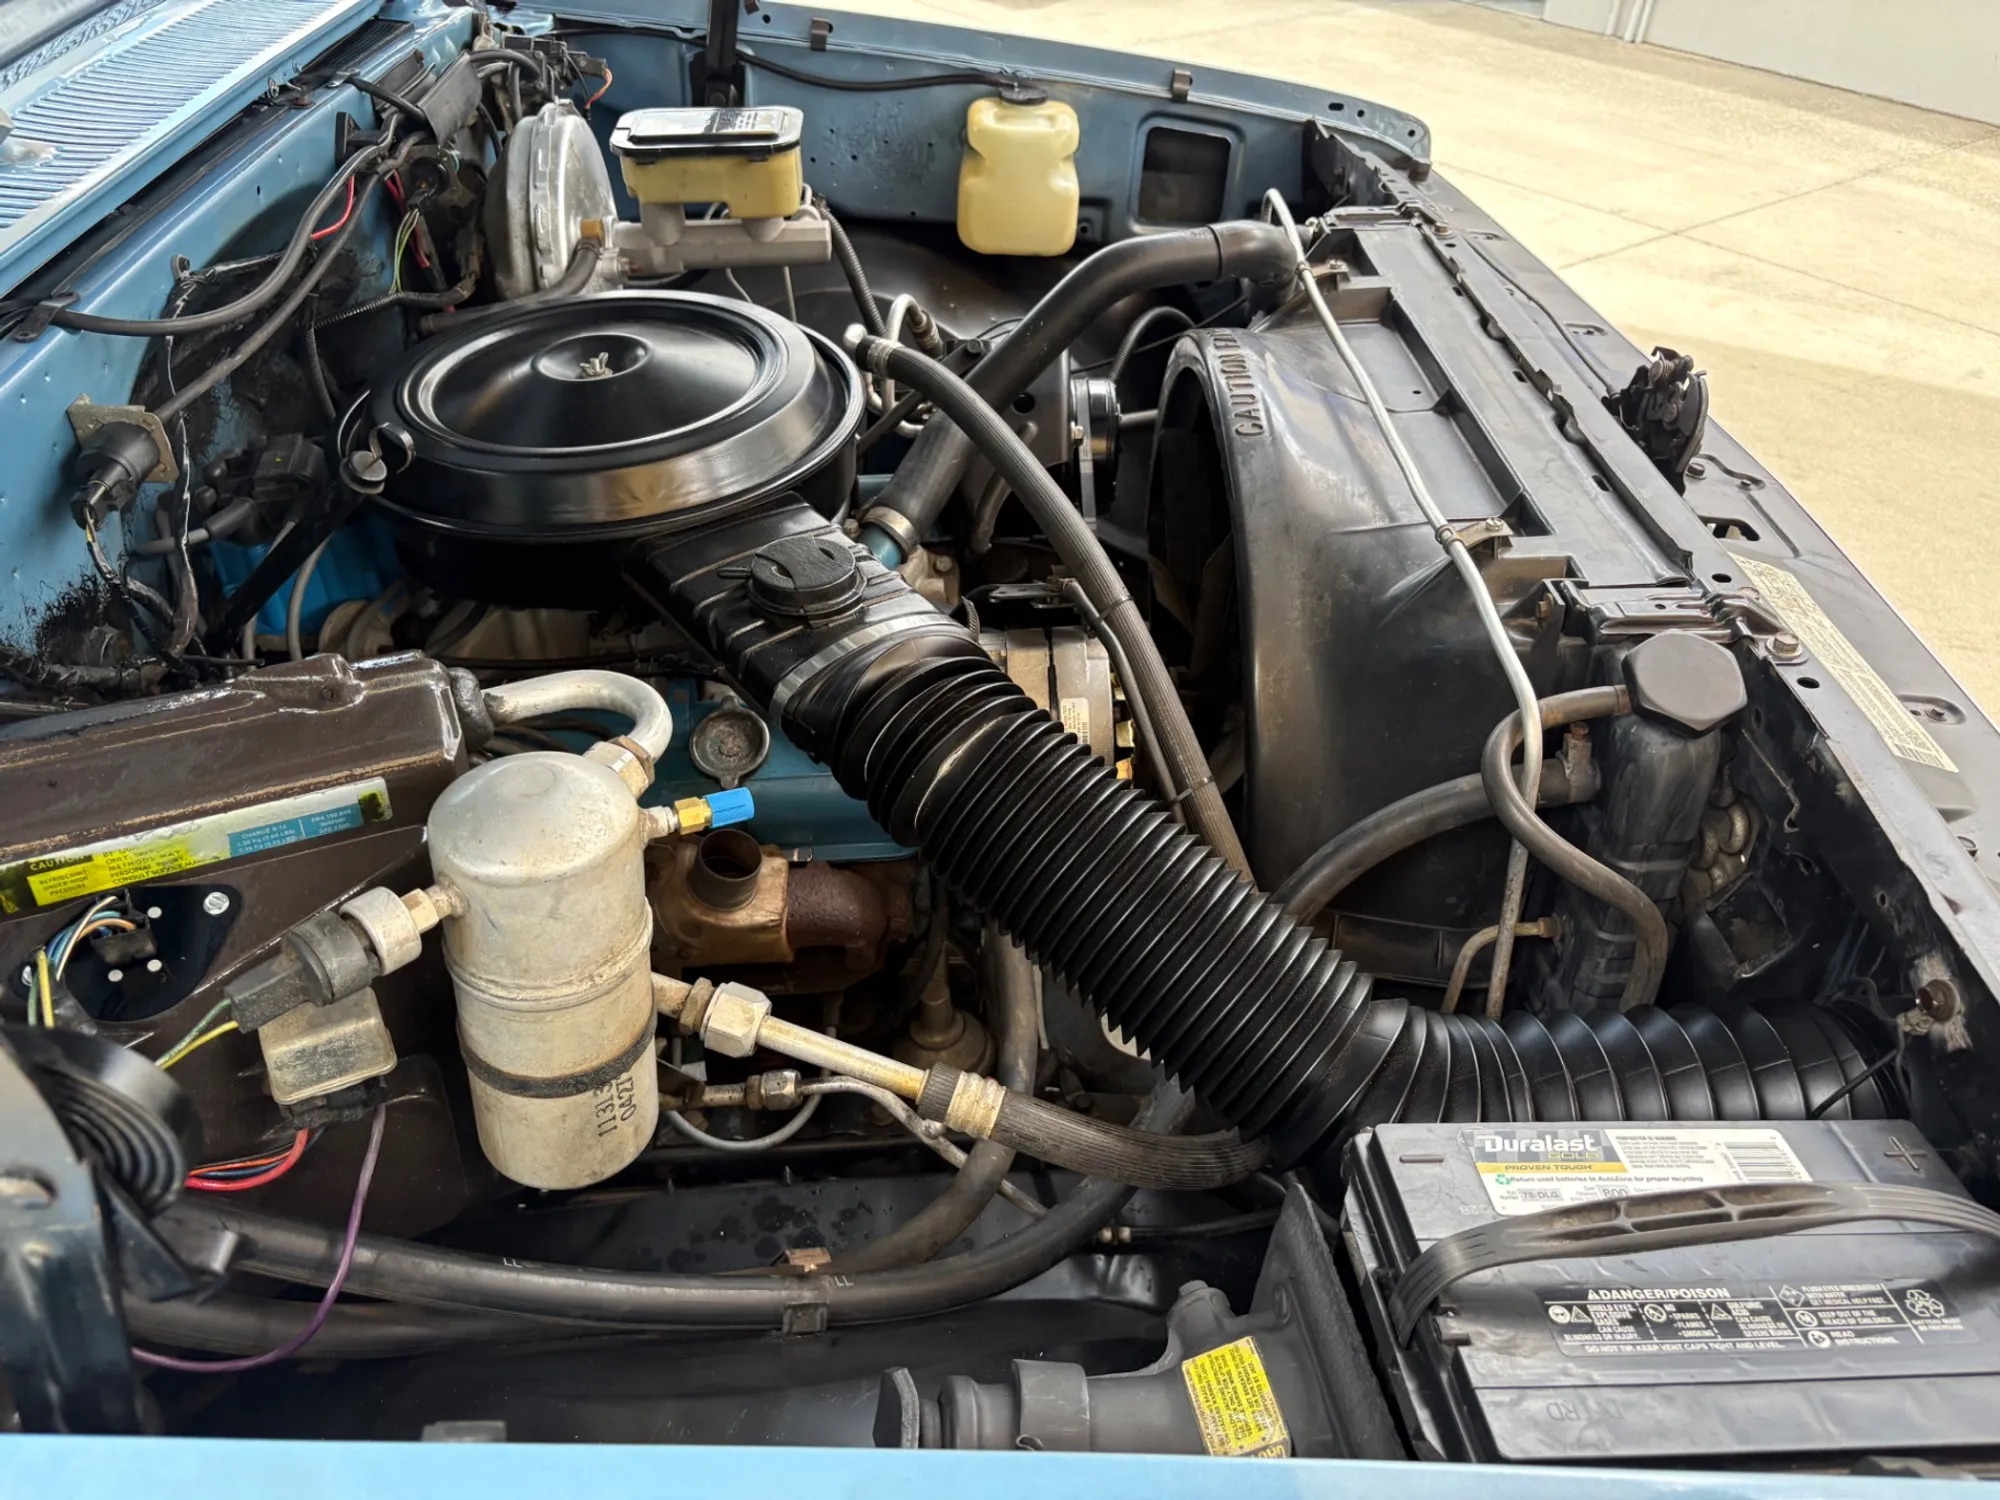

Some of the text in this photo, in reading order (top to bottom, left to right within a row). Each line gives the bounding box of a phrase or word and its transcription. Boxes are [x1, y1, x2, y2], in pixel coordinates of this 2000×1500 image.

[1218, 354, 1265, 436] CAUTION
[1476, 1134, 1597, 1153] Duralast
[1602, 1188, 1629, 1199] 800
[1598, 1288, 1731, 1300] DANGER/POISON
[1590, 1311, 1633, 1319] EXPLOSIVE
[1585, 1345, 1600, 1353] DO
[1600, 1344, 1618, 1352] NOT
[1636, 1344, 1660, 1352] KEEP
[1660, 1343, 1682, 1351] VENT
[1683, 1343, 1709, 1351] CAPS
[1708, 1342, 1735, 1350] TIGHT
